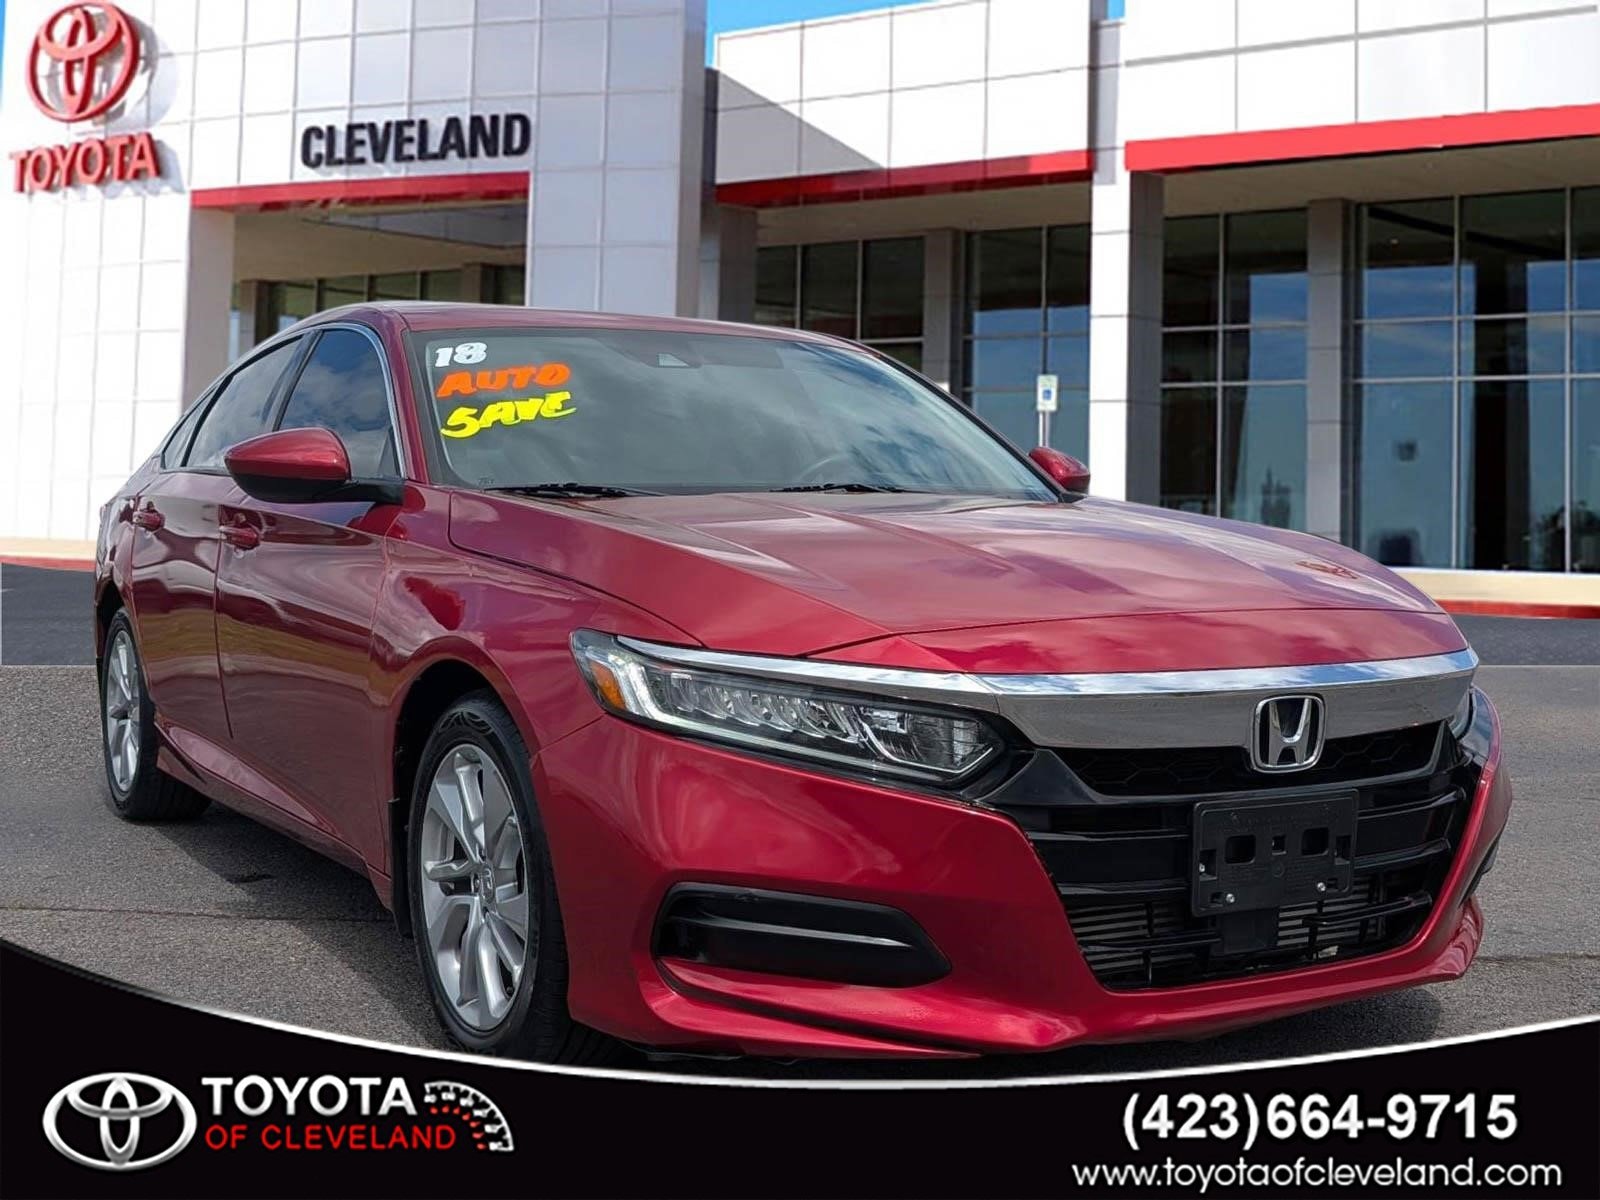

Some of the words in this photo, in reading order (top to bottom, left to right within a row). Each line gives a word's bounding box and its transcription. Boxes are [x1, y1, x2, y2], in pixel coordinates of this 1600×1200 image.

[9, 132, 163, 193] TOYOTA
[300, 113, 532, 169] CLEVELAND
[434, 342, 488, 368] 18
[436, 361, 571, 398] AUTO
[440, 391, 577, 438] SAVE
